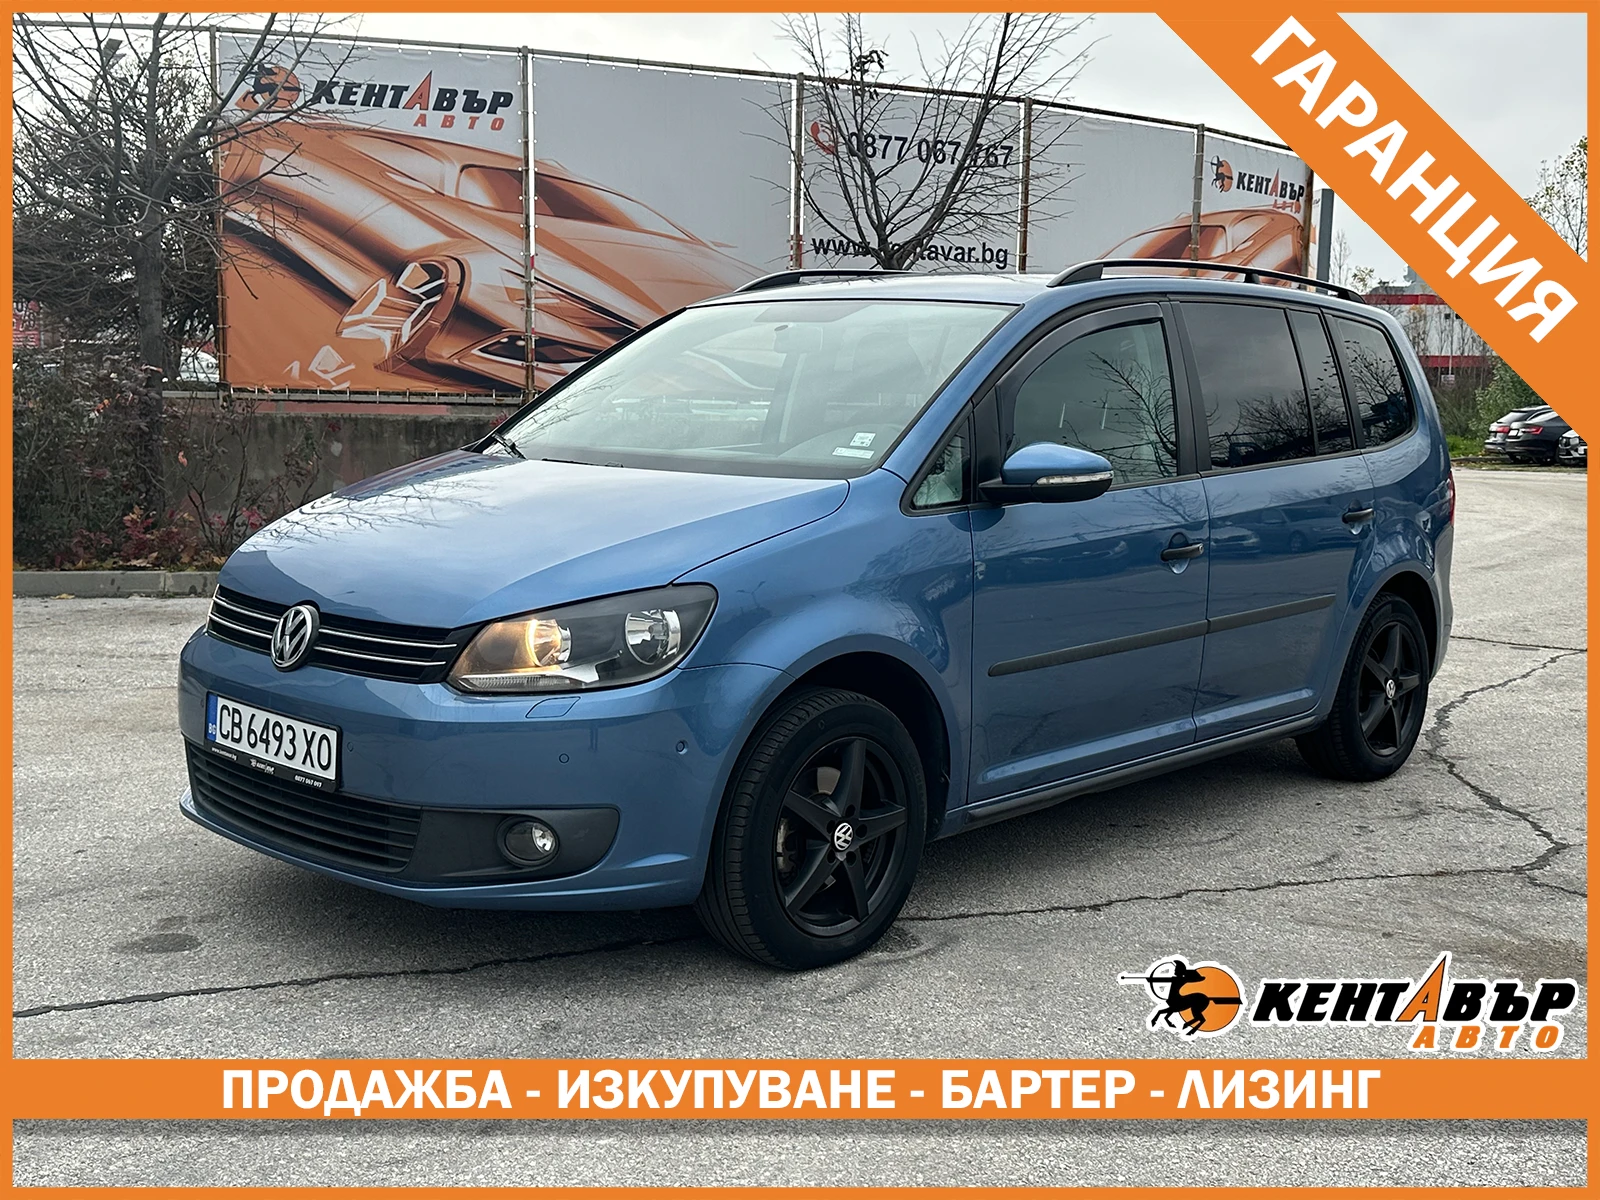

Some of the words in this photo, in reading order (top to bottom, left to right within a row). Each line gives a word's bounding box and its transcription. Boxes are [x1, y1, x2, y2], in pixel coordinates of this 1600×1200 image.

[315, 71, 514, 114] КЕНТАВЪР
[413, 113, 505, 131] АВТО
[849, 132, 908, 160] 0877
[917, 138, 961, 165] 067
[1236, 168, 1305, 202] КЕНТАВЪР
[219, 704, 243, 744] CB
[247, 713, 297, 761] 6493
